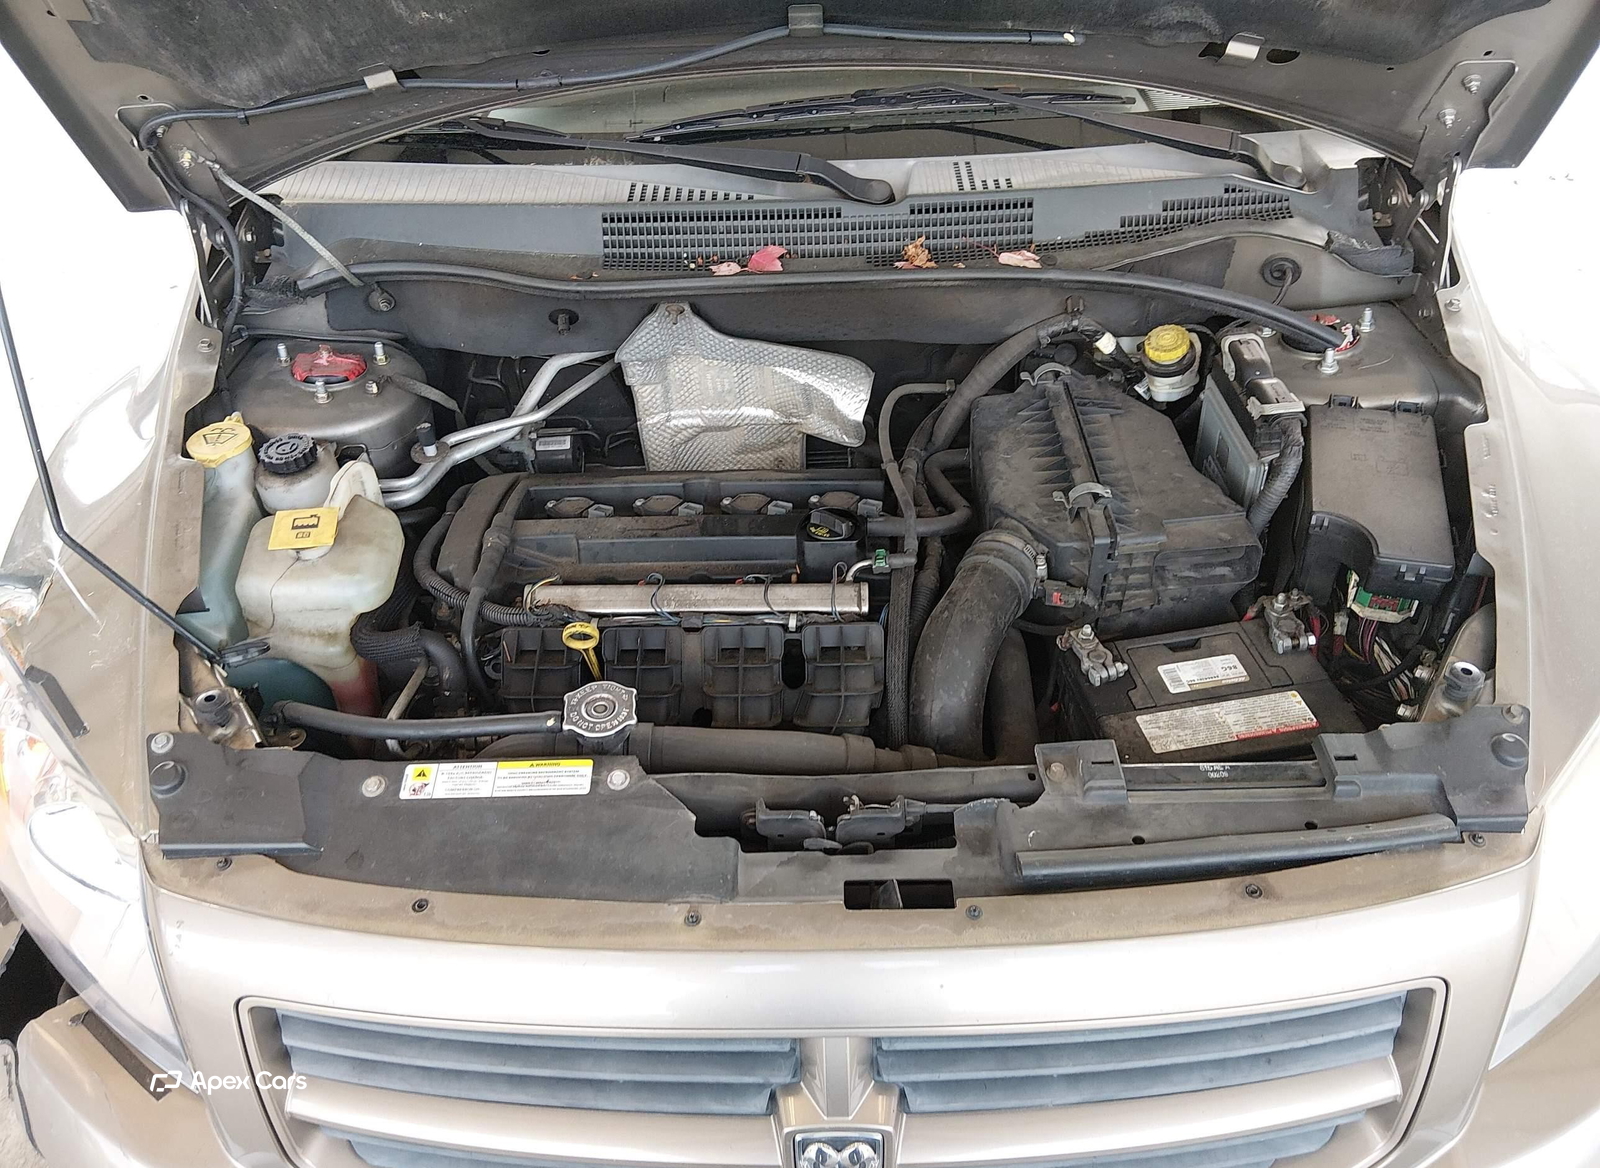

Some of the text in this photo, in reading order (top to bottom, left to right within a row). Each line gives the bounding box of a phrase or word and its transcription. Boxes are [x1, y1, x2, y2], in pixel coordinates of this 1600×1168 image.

[570, 711, 579, 722] DO
[577, 719, 594, 730] NOT
[595, 719, 619, 732] OPEN
